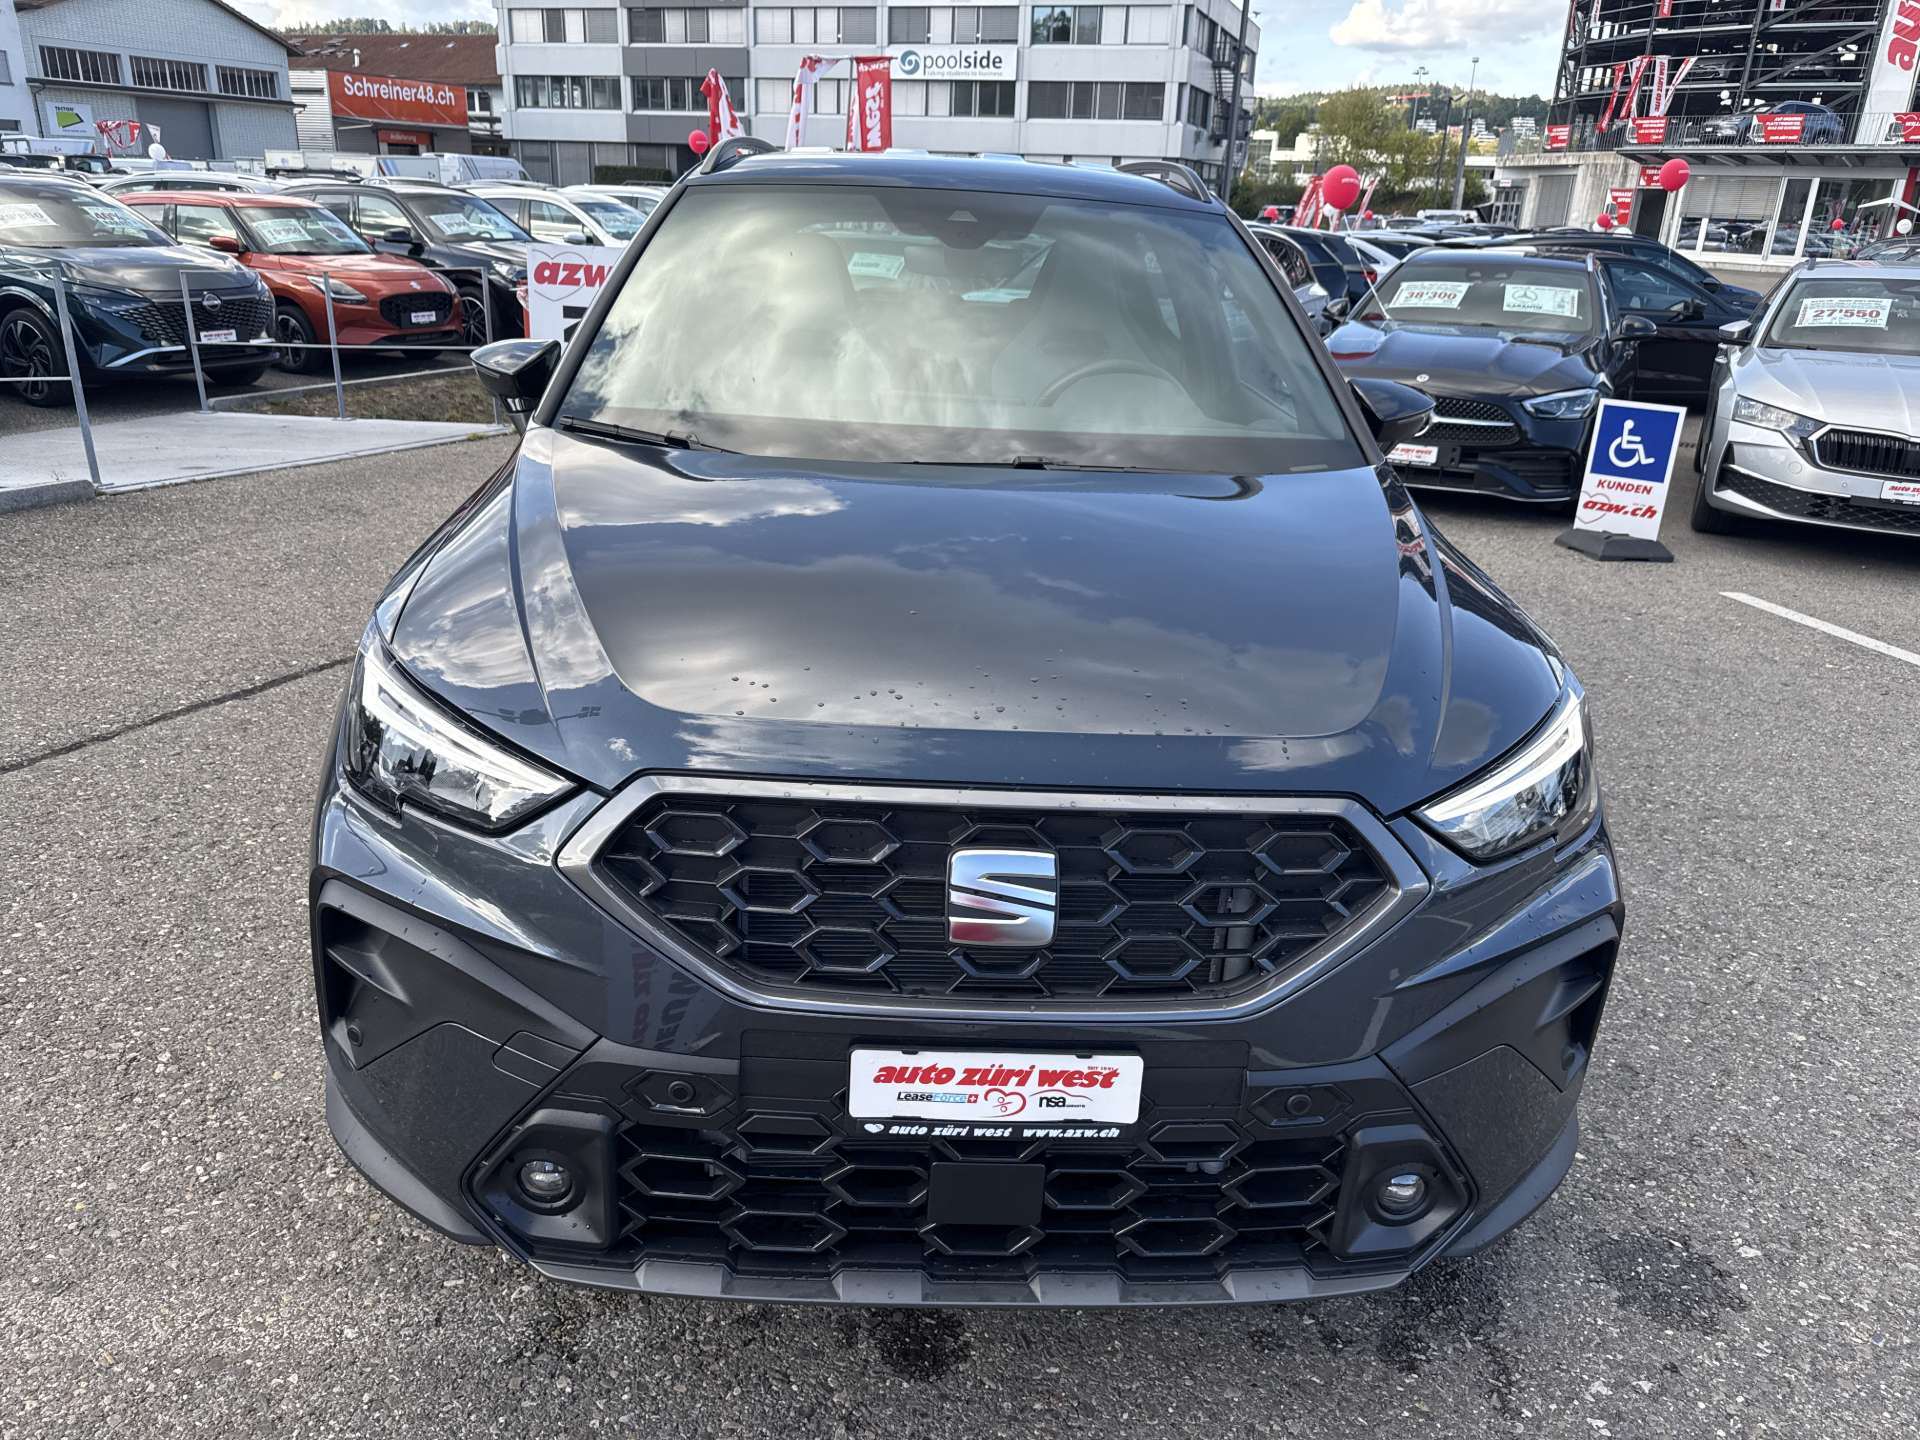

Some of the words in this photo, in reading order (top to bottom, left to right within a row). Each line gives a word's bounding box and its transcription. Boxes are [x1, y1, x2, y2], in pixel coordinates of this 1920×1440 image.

[1887, 0, 1920, 71] au
[923, 49, 1003, 76] poolside
[343, 75, 455, 106] Schreiner48.ch
[1406, 290, 1457, 300] 38'300
[1812, 308, 1881, 318] 27'550
[1596, 479, 1653, 495] KUNDEN
[1582, 500, 1657, 519] azw.ch
[873, 1062, 956, 1085] auto
[955, 1063, 1036, 1087] züri
[1036, 1068, 1120, 1089] west
[897, 1091, 967, 1104] LeaseForce
[1038, 1096, 1067, 1108] nsa
[888, 1124, 929, 1135] auto
[931, 1124, 970, 1138] züri
[973, 1126, 1013, 1138] west
